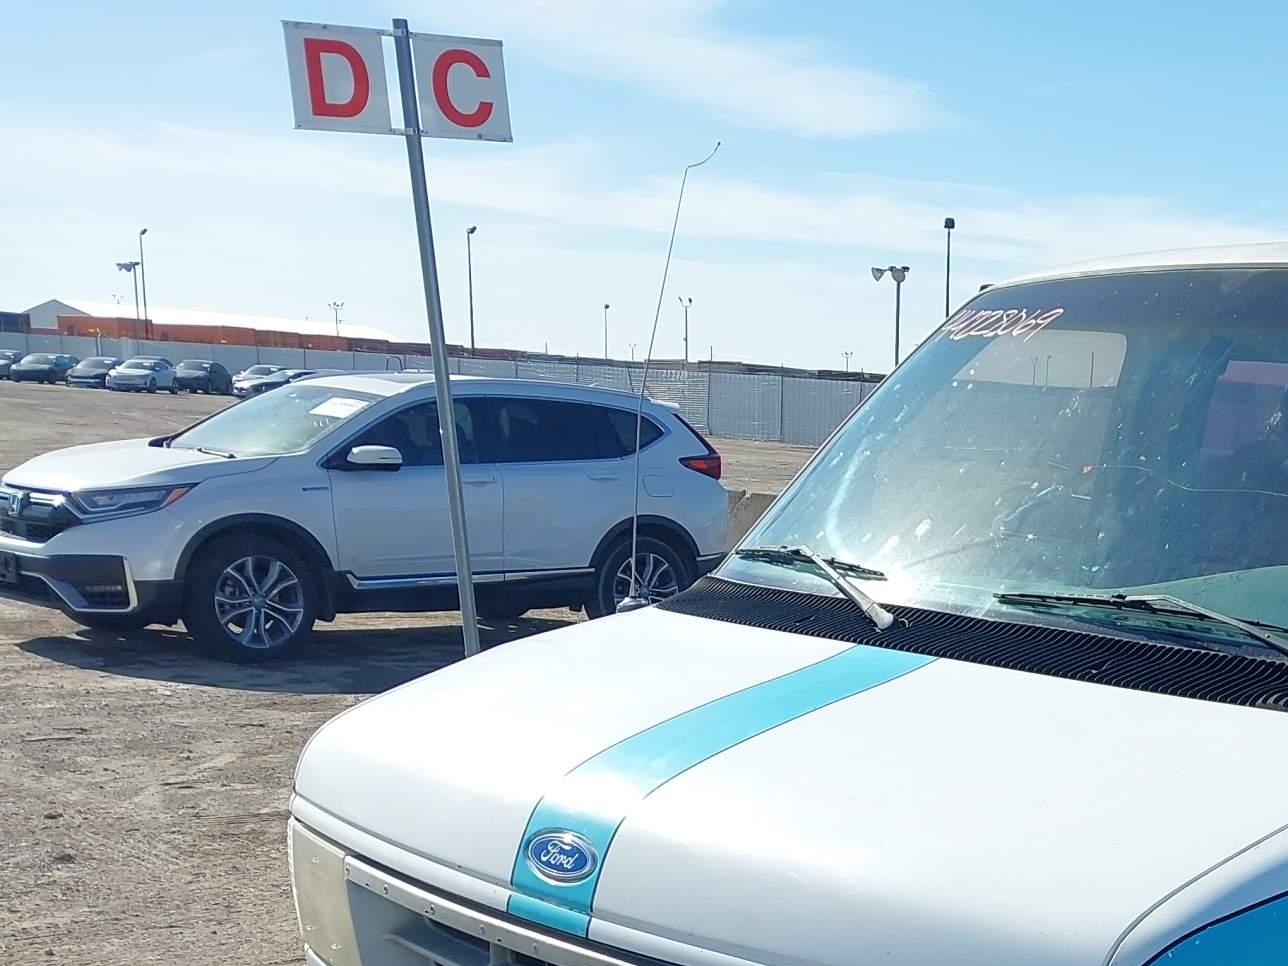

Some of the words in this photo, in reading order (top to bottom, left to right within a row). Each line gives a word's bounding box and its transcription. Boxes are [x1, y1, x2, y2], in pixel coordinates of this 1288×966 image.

[304, 37, 369, 118] D
[432, 49, 493, 127] C
[541, 841, 579, 869] Ford
